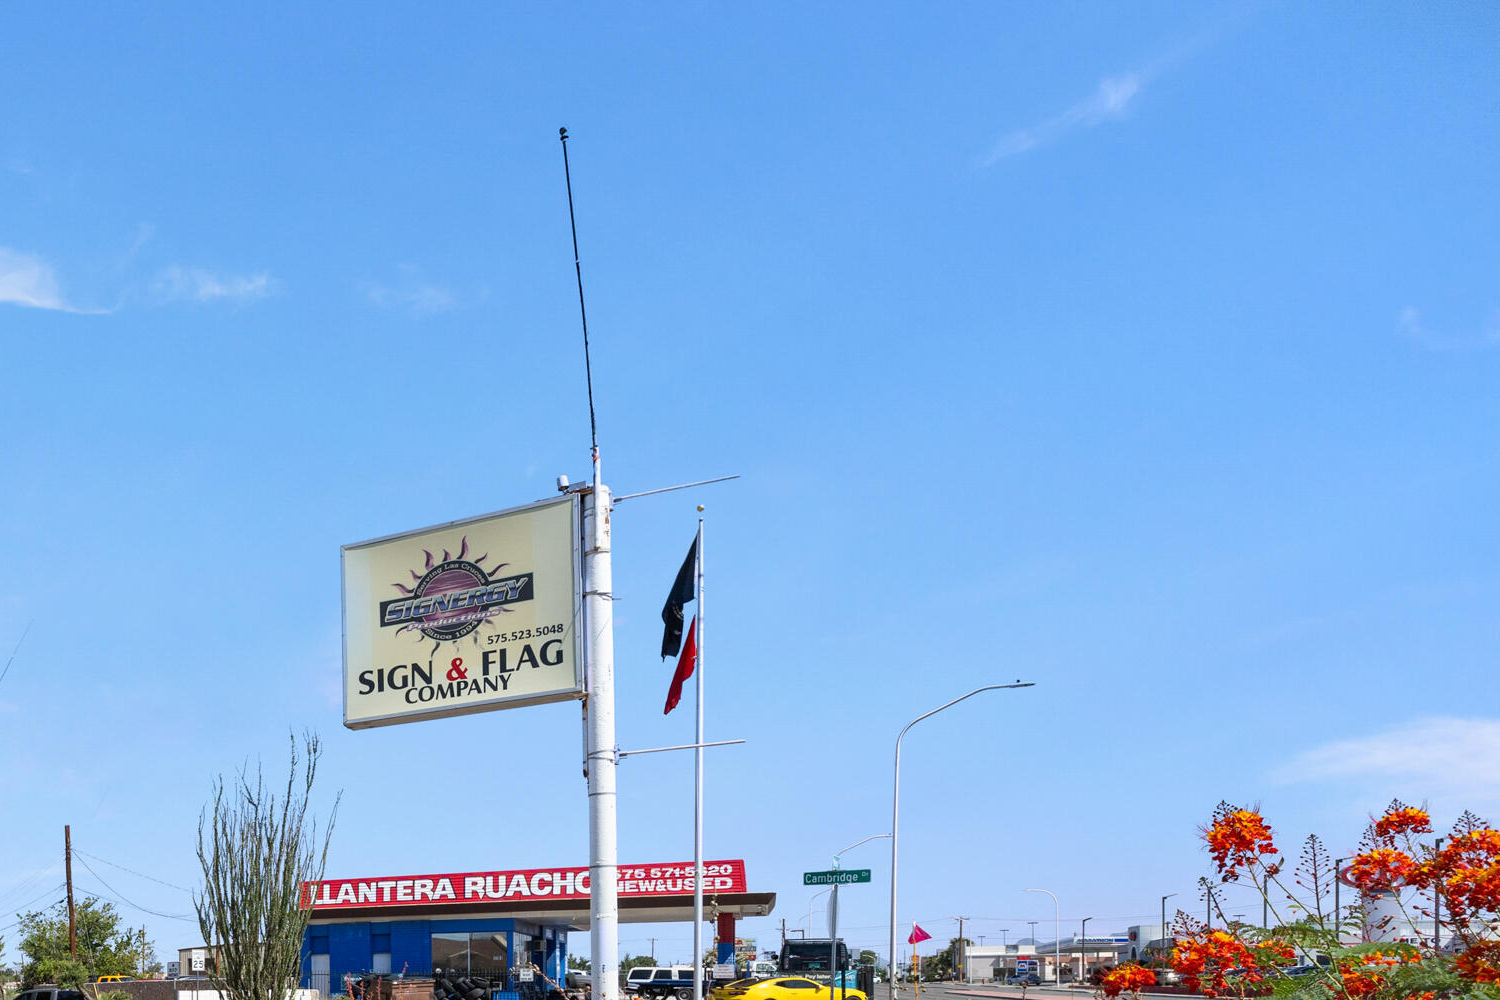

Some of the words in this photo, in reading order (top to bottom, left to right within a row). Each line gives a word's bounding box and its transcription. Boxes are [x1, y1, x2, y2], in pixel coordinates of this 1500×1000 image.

[416, 567, 443, 596] Serving
[461, 563, 486, 584] Cruces
[385, 576, 529, 623] SIGNERGY
[406, 609, 502, 631] Productions
[425, 628, 452, 640] Since
[487, 623, 564, 645] 575.523.5048
[358, 660, 433, 695] SIGN
[446, 657, 468, 681] &
[482, 639, 564, 676] FLAG
[404, 673, 512, 704] COMPANY
[805, 873, 859, 884] Cambridge
[310, 878, 457, 905] LLANTERA
[193, 960, 204, 969] 25
